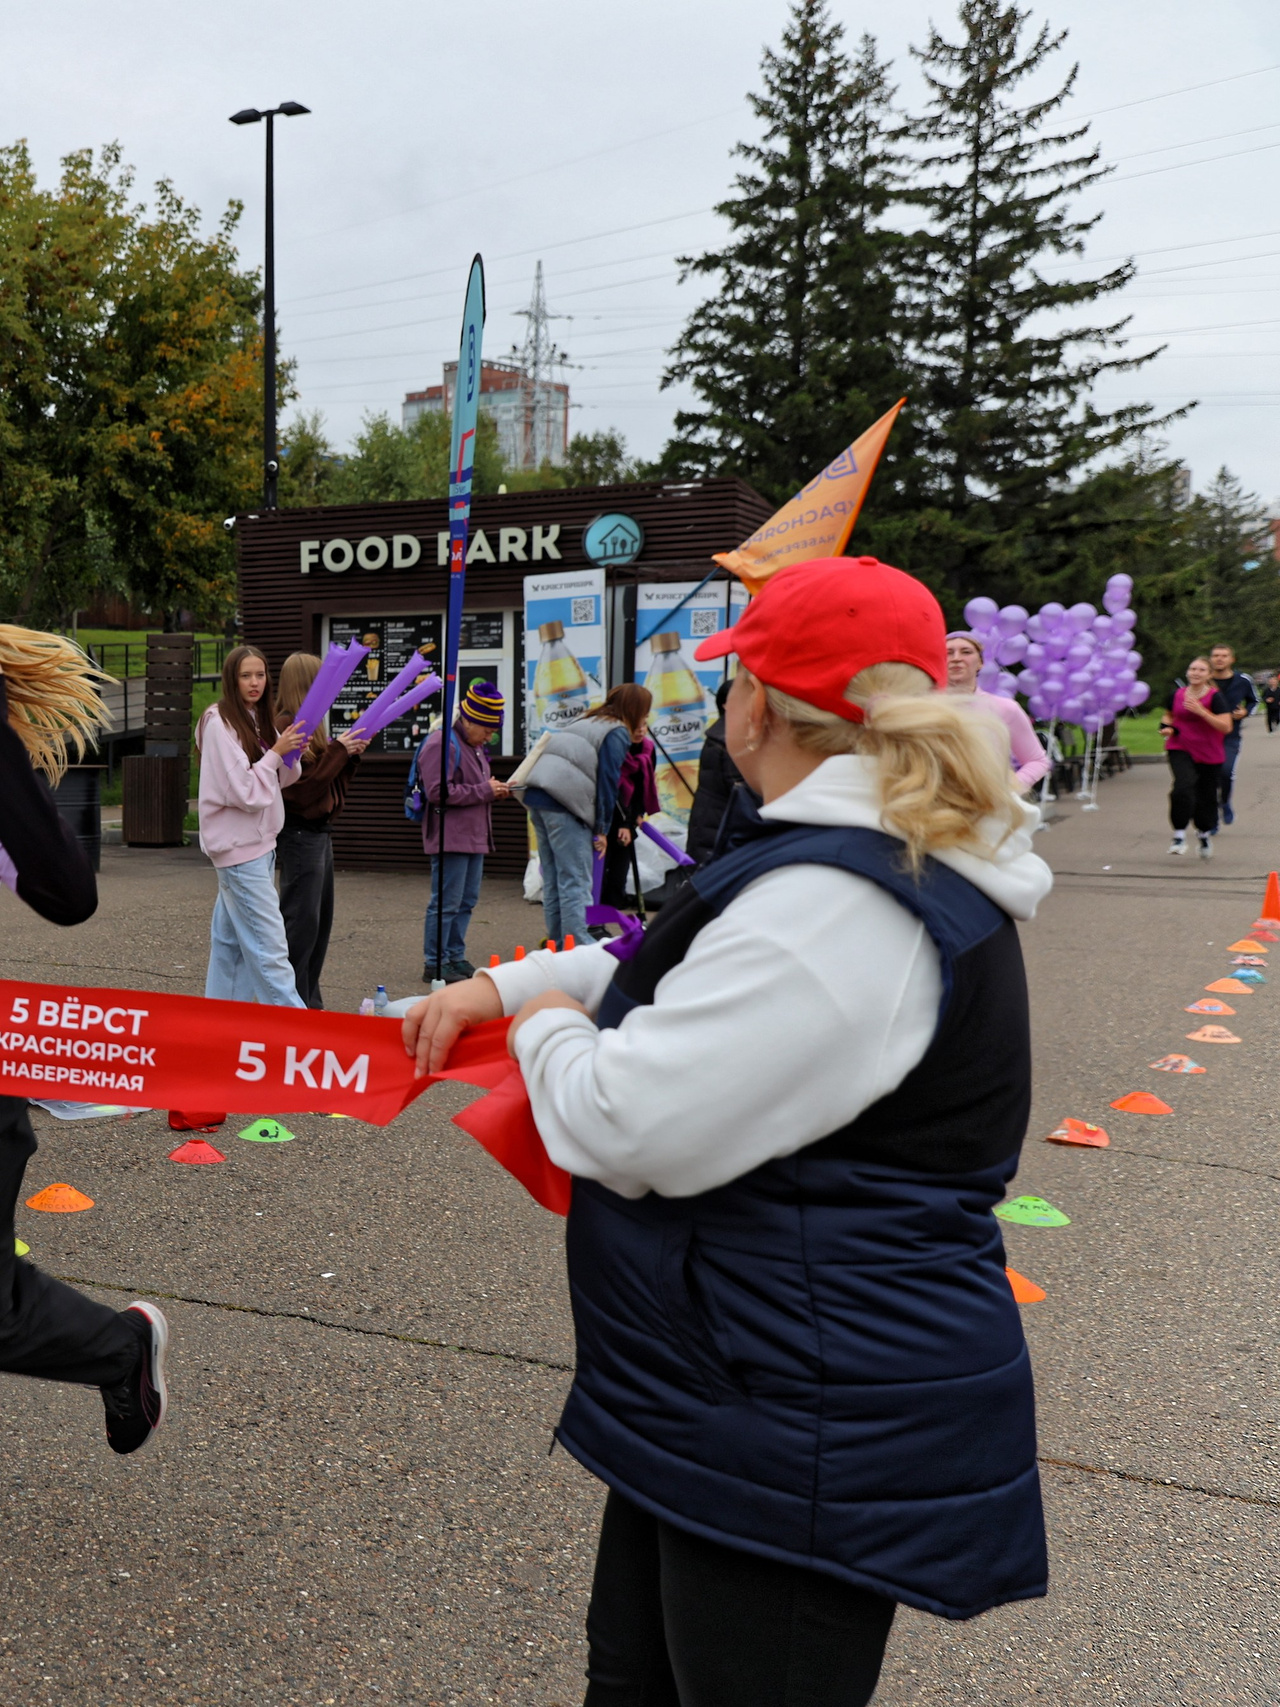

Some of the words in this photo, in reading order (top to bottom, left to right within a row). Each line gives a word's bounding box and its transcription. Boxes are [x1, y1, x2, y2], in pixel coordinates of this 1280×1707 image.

[300, 534, 421, 574] FOOD
[653, 721, 701, 737] БОЧКАРИ
[10, 998, 30, 1024] 5
[37, 996, 149, 1036] ВЁРСТ
[2, 1060, 144, 1092] НАБЕРЕЖНАЯ
[235, 1041, 267, 1081] 5
[283, 1046, 370, 1093] КМ
